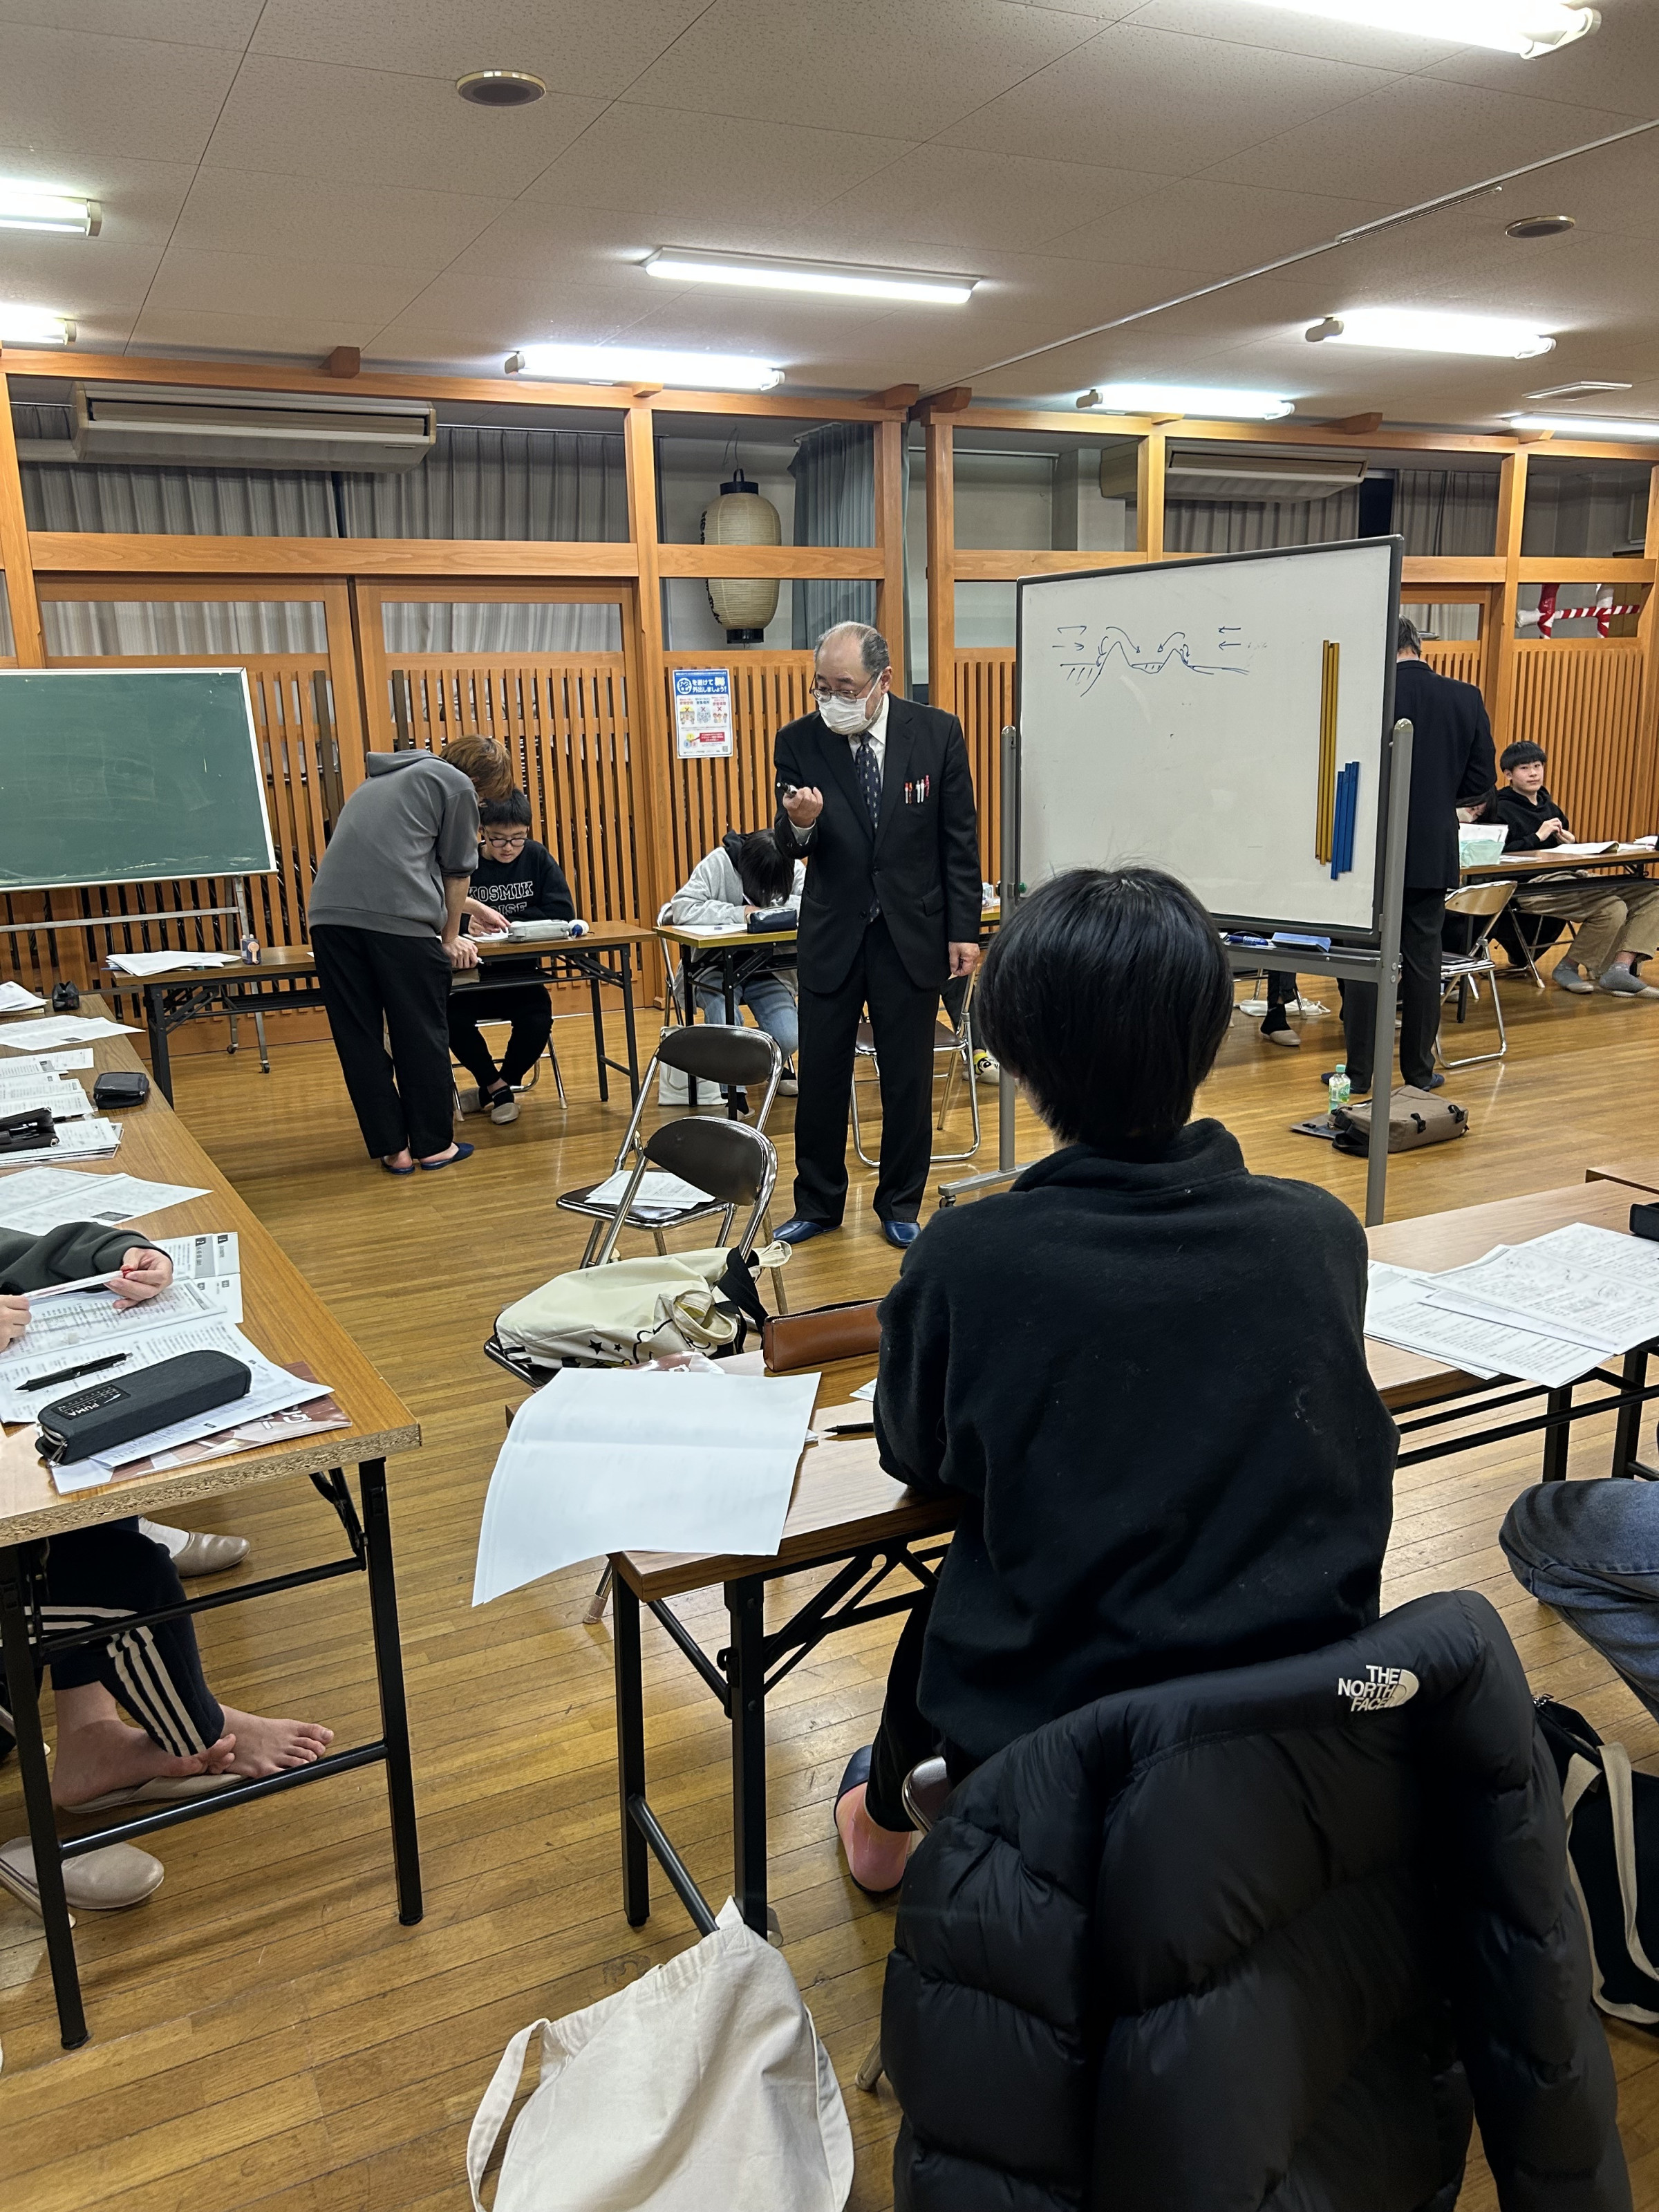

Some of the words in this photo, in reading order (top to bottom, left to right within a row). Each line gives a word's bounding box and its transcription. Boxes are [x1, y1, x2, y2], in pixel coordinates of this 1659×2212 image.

[468, 881, 534, 902] KOSMIK
[68, 1403, 100, 1416] PUMA
[1365, 1665, 1400, 1685] THE
[1338, 1678, 1396, 1698] NORTH
[1350, 1696, 1389, 1712] FACE
